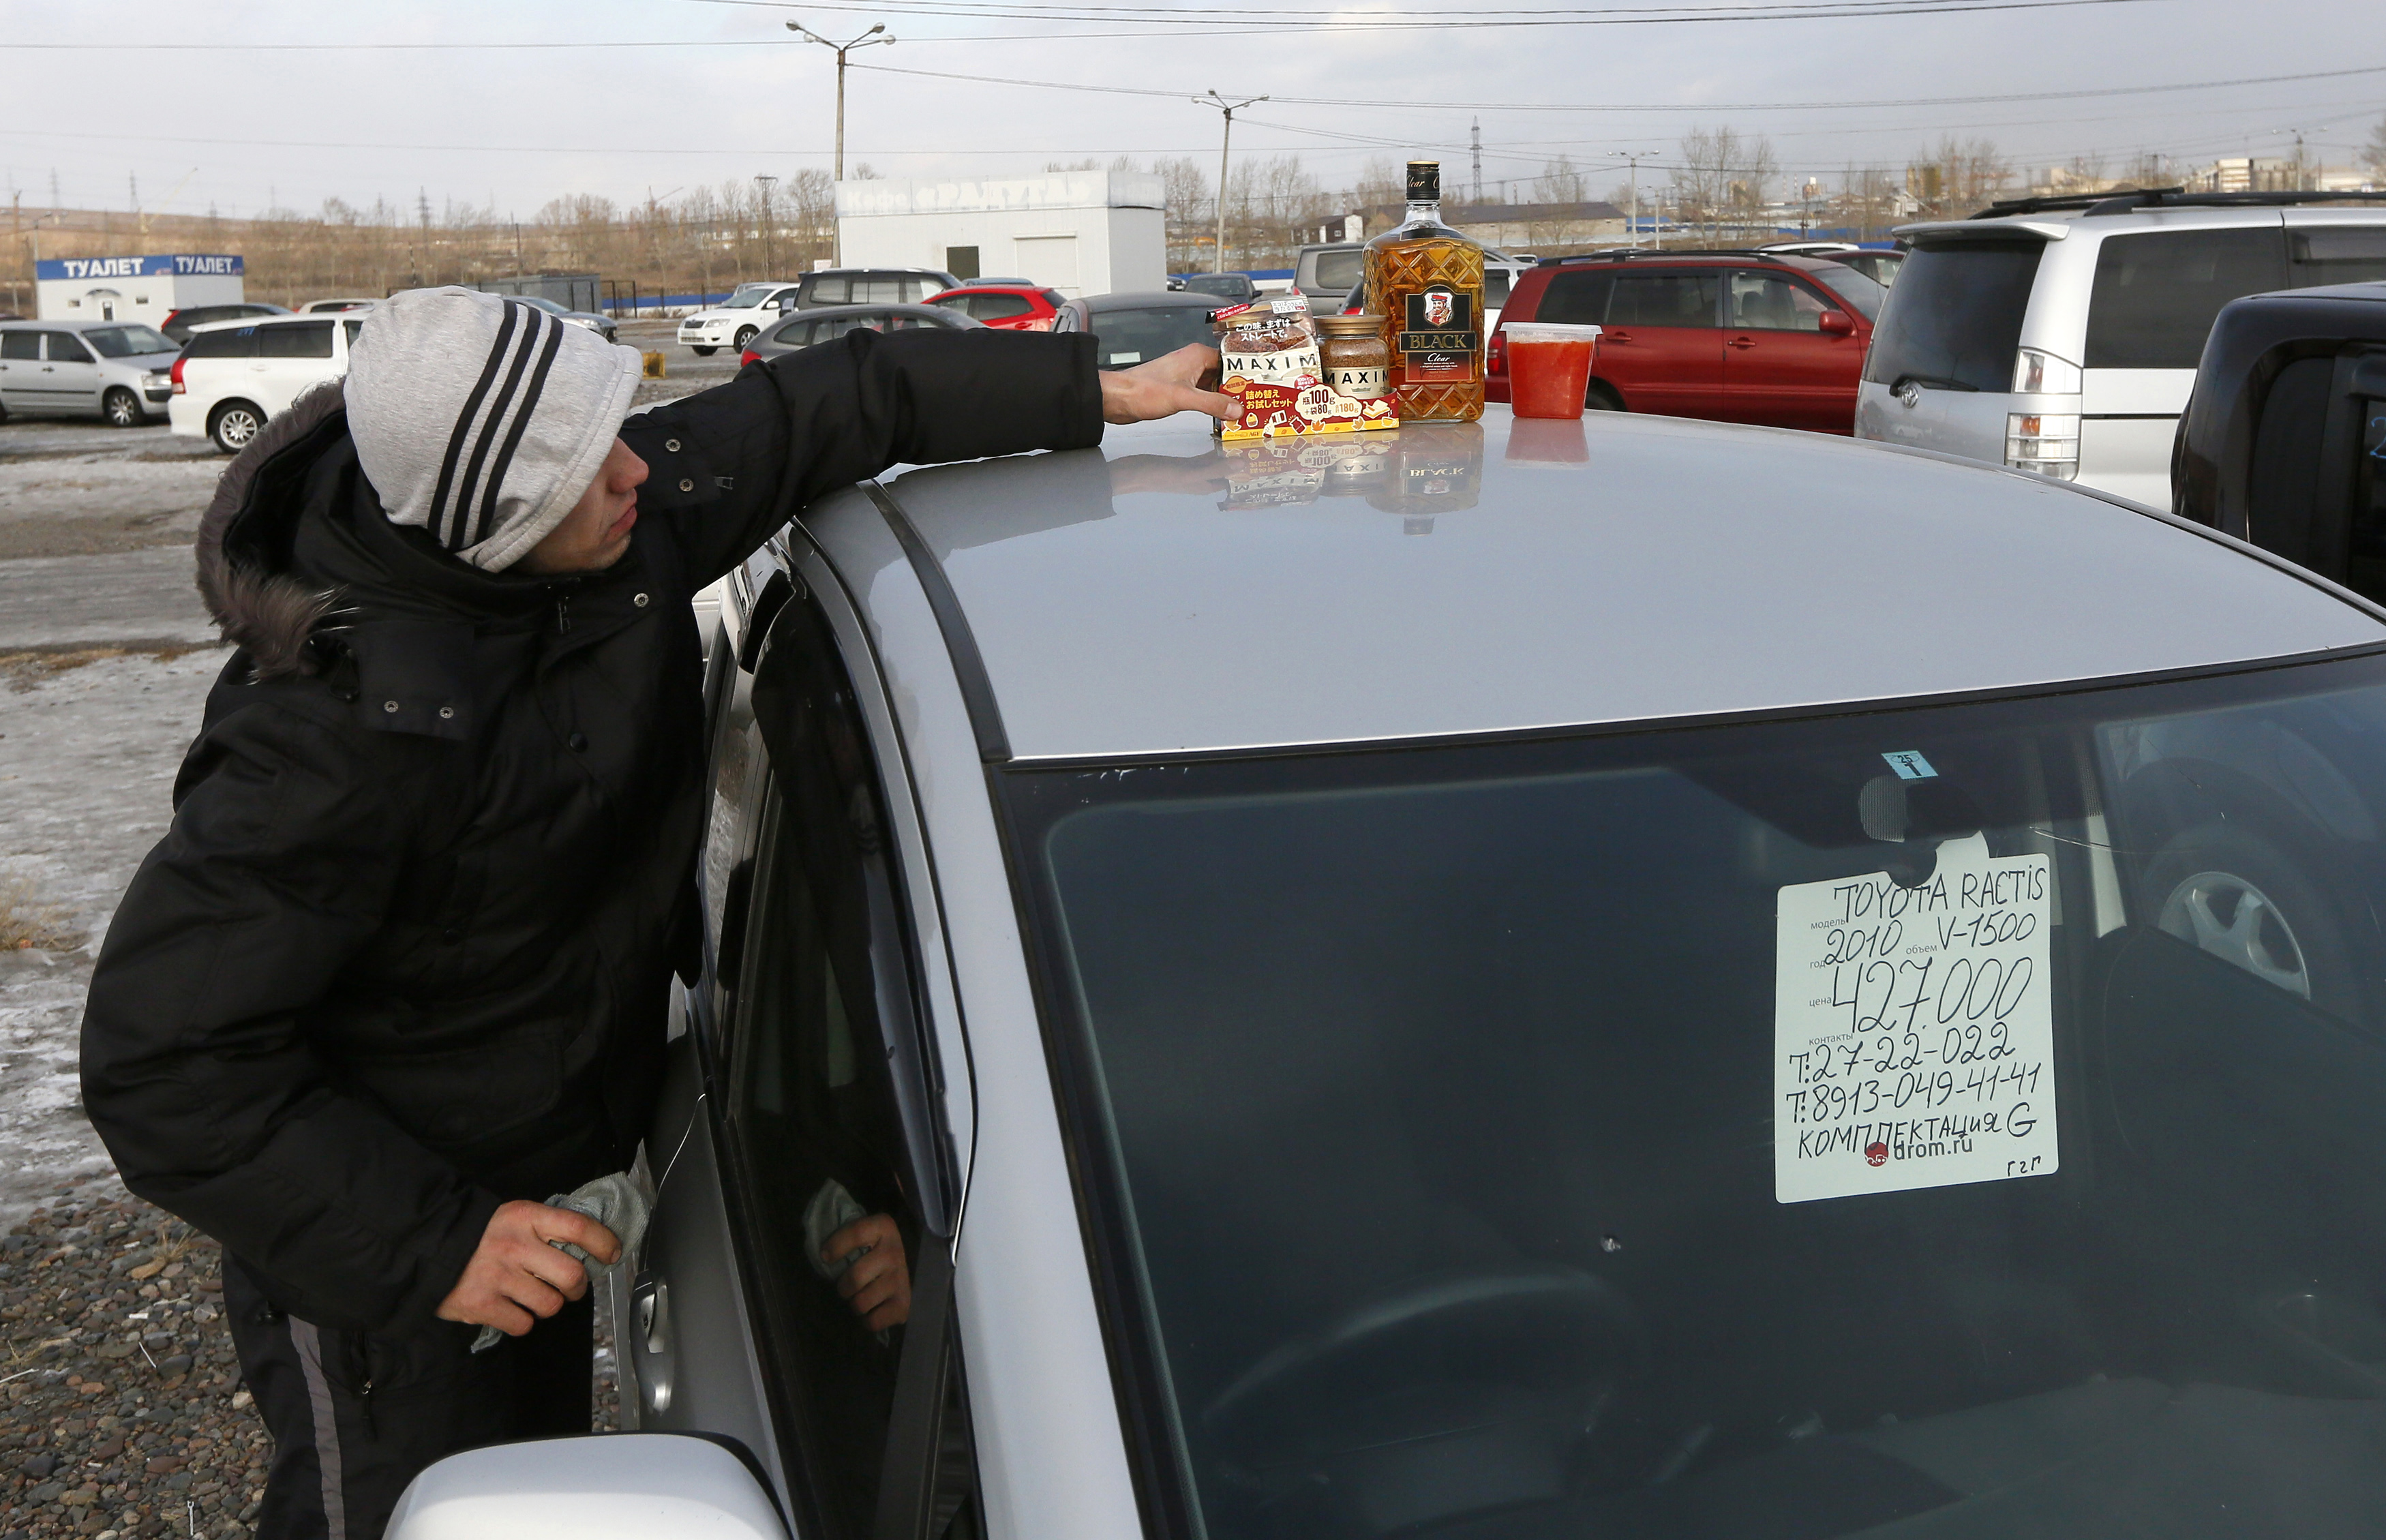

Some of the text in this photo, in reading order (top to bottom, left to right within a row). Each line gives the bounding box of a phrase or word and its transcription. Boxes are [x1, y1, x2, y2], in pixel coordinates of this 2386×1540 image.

[846, 190, 907, 209] Кафе
[63, 257, 145, 277] ТУАЛЕТ
[175, 256, 234, 273] ТУАЛЕТ
[1235, 318, 1291, 332] この味、まずは
[1409, 335, 1467, 348] BLACK
[1227, 354, 1316, 371] MAXIM
[1428, 352, 1450, 362] Clear
[1323, 369, 1389, 384] MAXIM
[1245, 389, 1280, 400] 詰め替え
[1246, 399, 1293, 410] お試しセット
[1897, 754, 1913, 763] 25
[1834, 864, 2047, 922] TOYOTA RACTIS
[1810, 918, 1846, 930] модель
[1937, 910, 2036, 950] V-1500
[1824, 920, 1903, 965] 2010
[1905, 943, 1937, 954] объем
[1810, 960, 1826, 969] год
[1832, 956, 2033, 1033] 427.000
[1809, 997, 1832, 1007] цена
[1809, 1033, 1854, 1046] контакты
[2007, 1102, 2037, 1137] G
[1894, 1136, 1973, 1160] drom.ru
